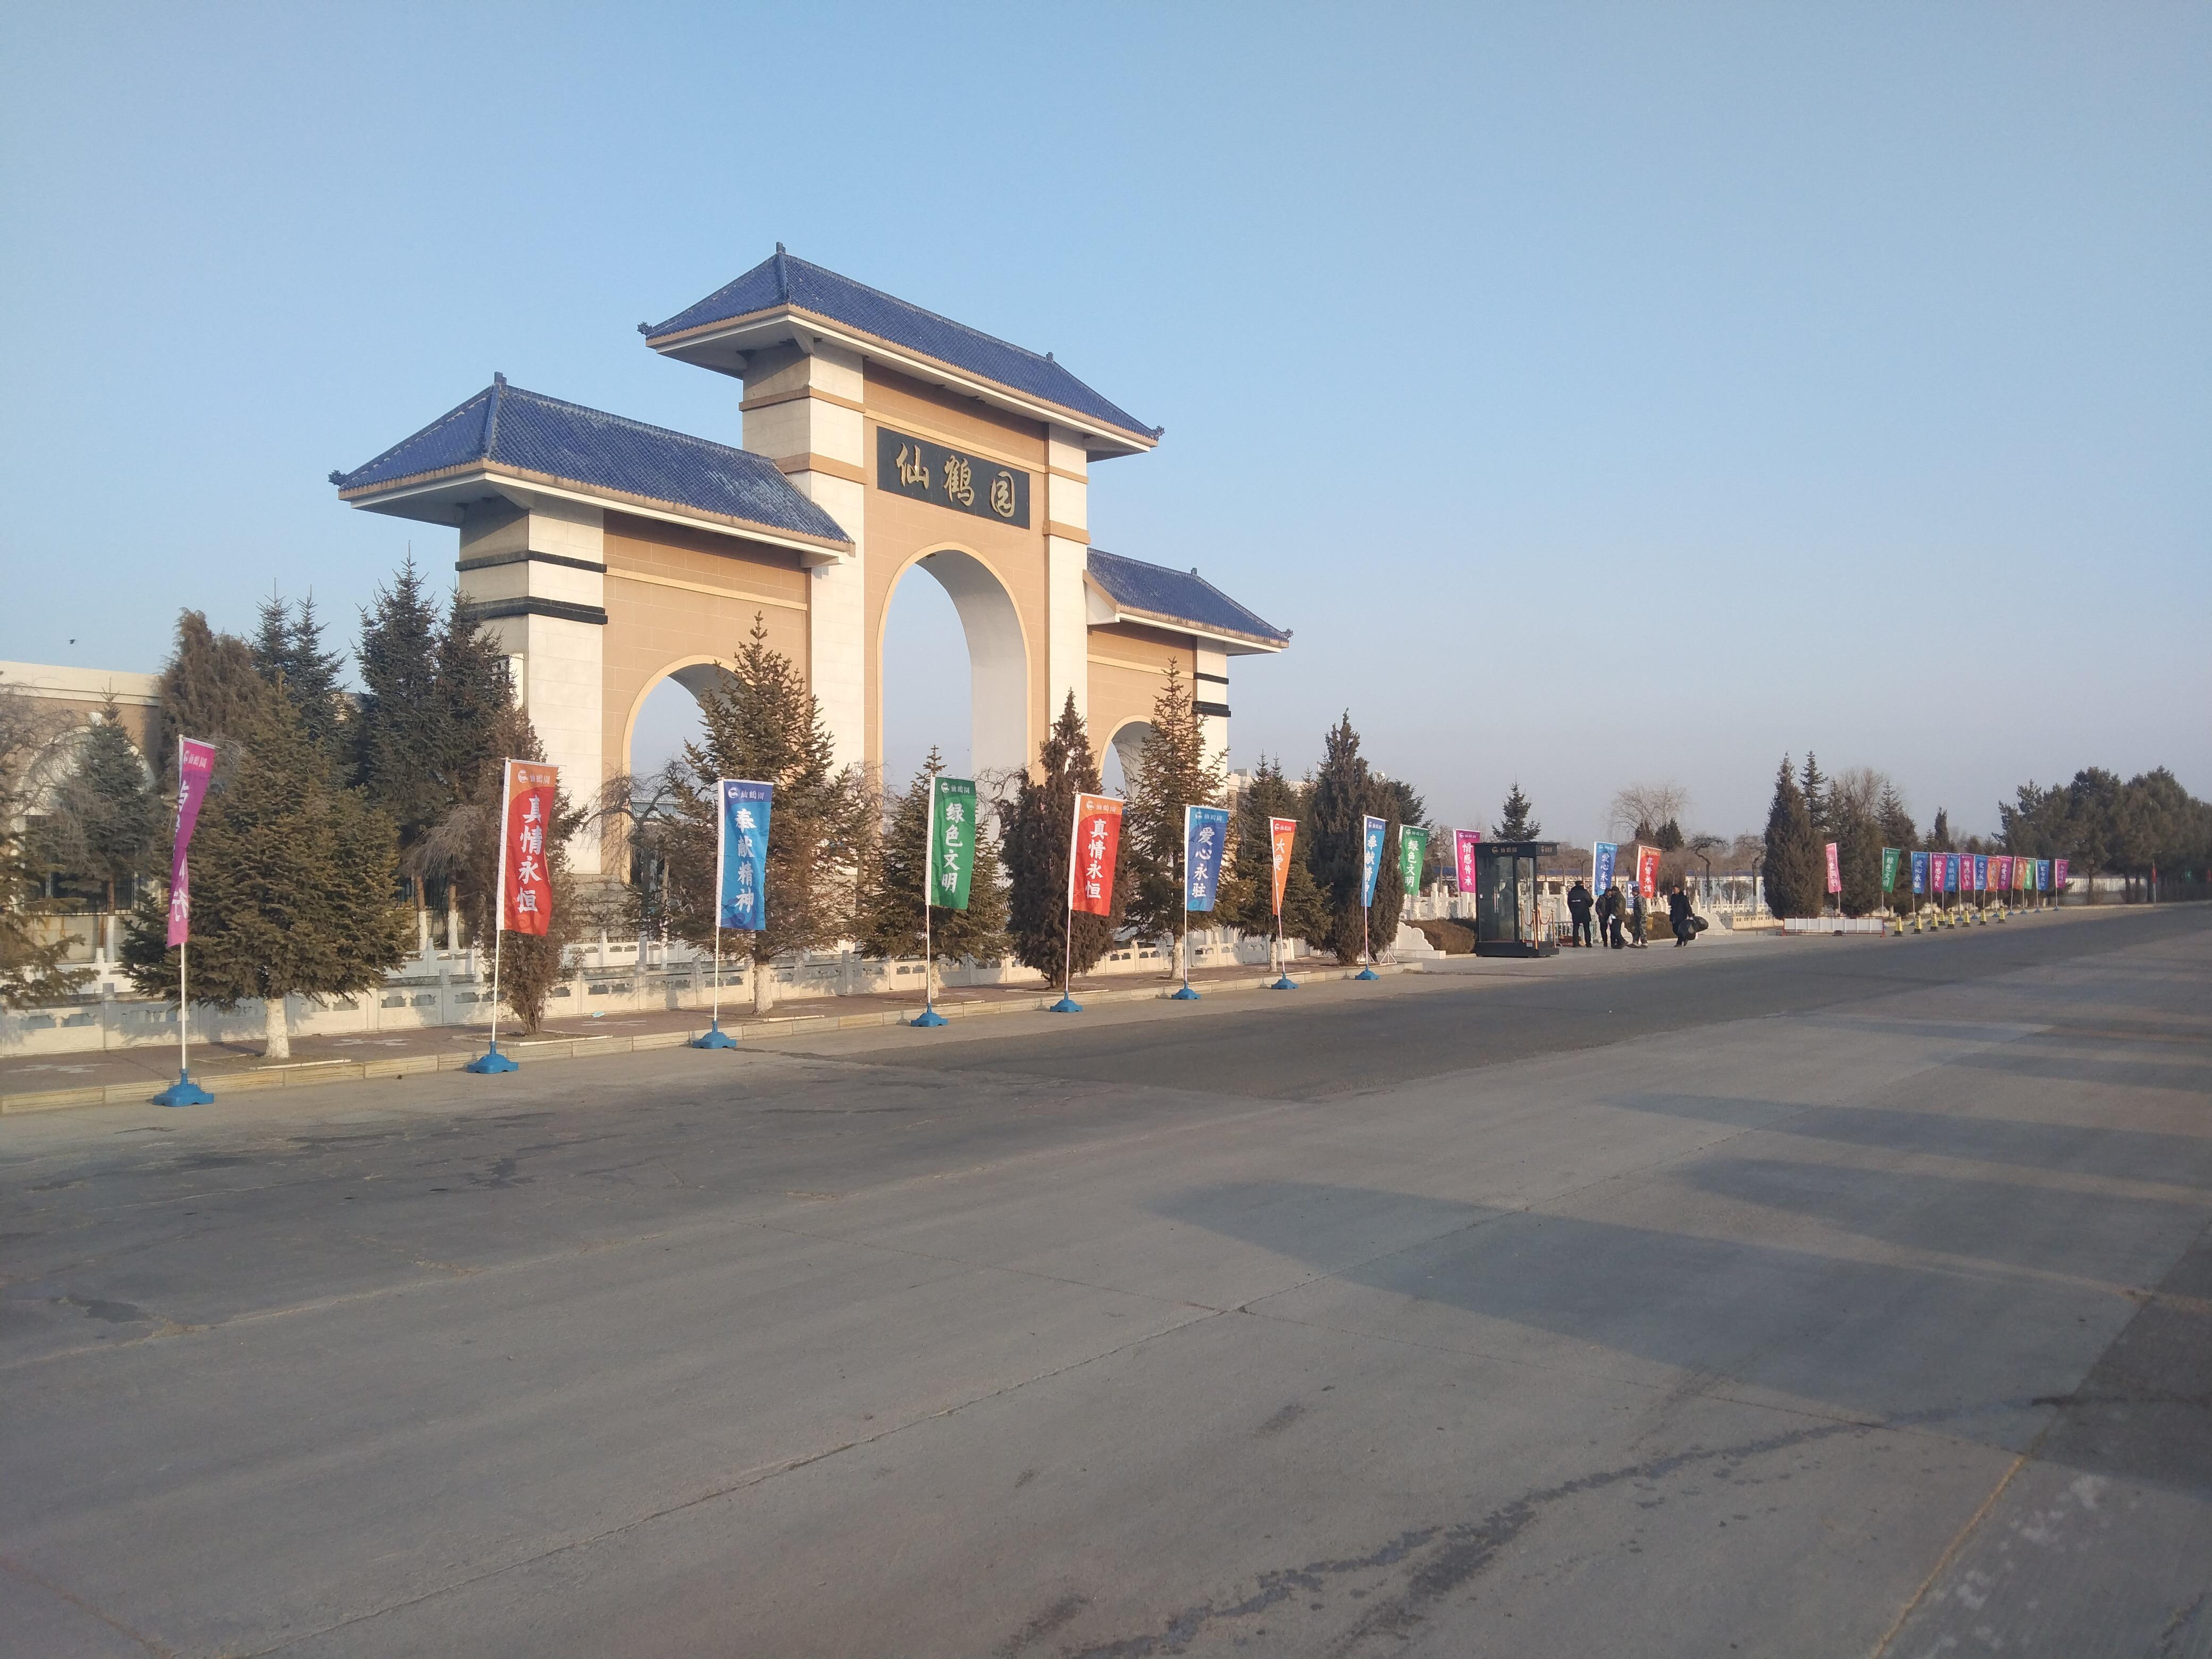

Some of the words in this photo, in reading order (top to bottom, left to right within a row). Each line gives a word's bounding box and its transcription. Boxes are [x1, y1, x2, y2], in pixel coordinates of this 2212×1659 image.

[516, 794, 543, 914] 真情永恒
[735, 808, 757, 914] 奉献精神
[942, 802, 966, 893] 绿色文明
[1085, 818, 1109, 899] 真情永恒
[1191, 827, 1215, 898] 爱心永驻
[1404, 839, 1419, 887] 绿色文明
[1462, 842, 1473, 886] 情感传承
[1599, 853, 1610, 890] 爱心永驻
